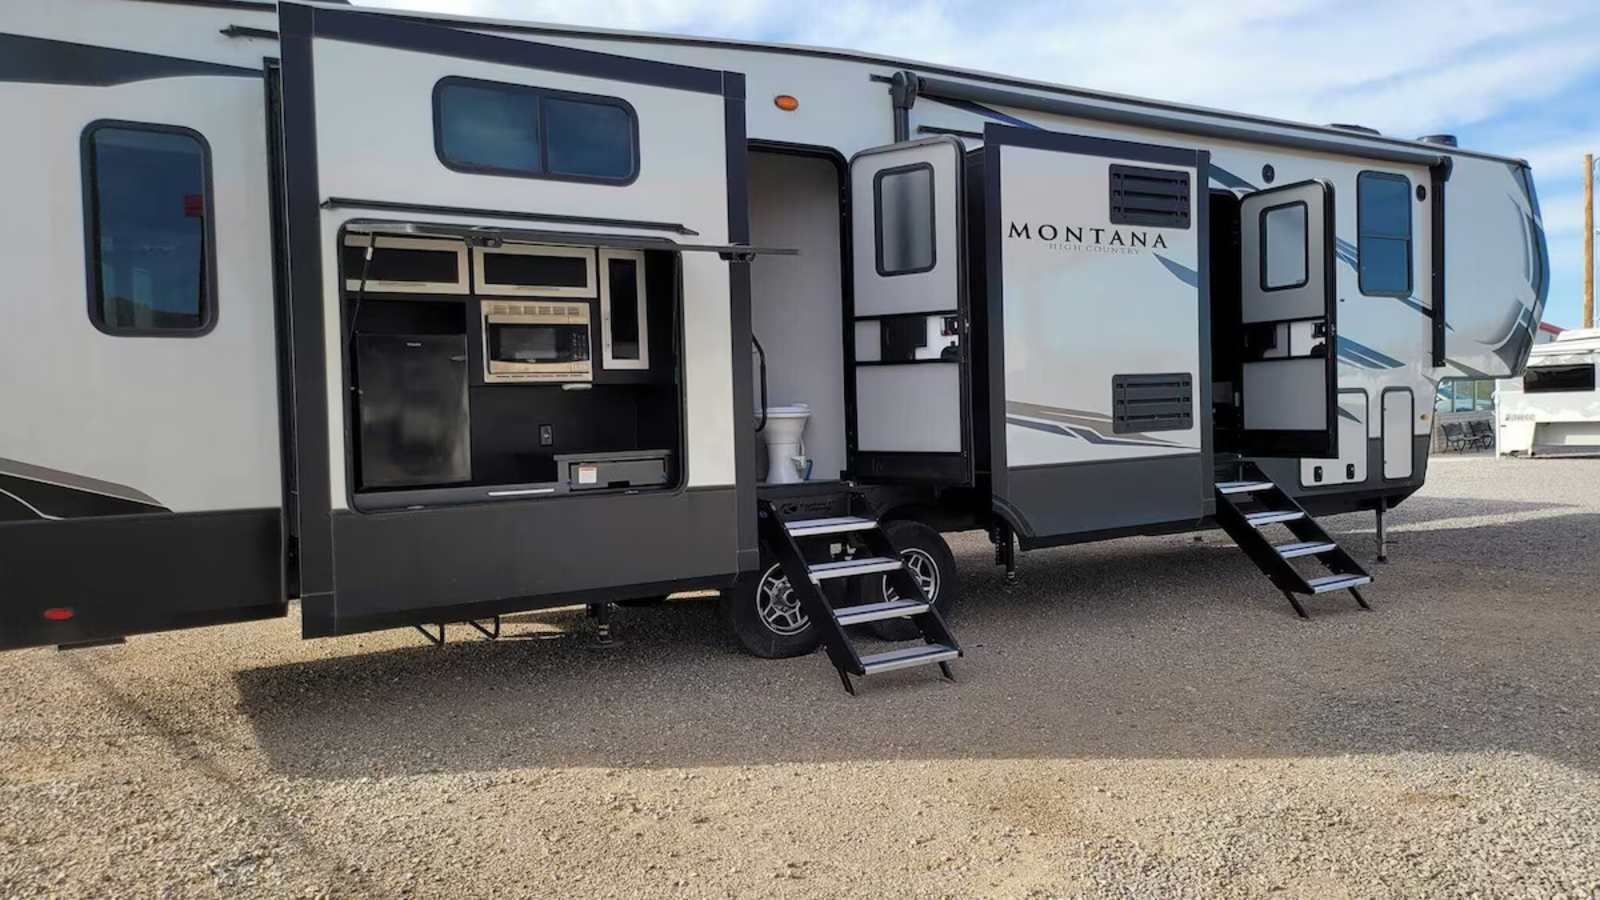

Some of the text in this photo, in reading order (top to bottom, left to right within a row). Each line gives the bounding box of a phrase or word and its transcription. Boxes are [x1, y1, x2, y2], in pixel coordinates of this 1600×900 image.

[1008, 221, 1168, 249] MONTANA
[1049, 242, 1139, 255] HIGH COUNTRY
